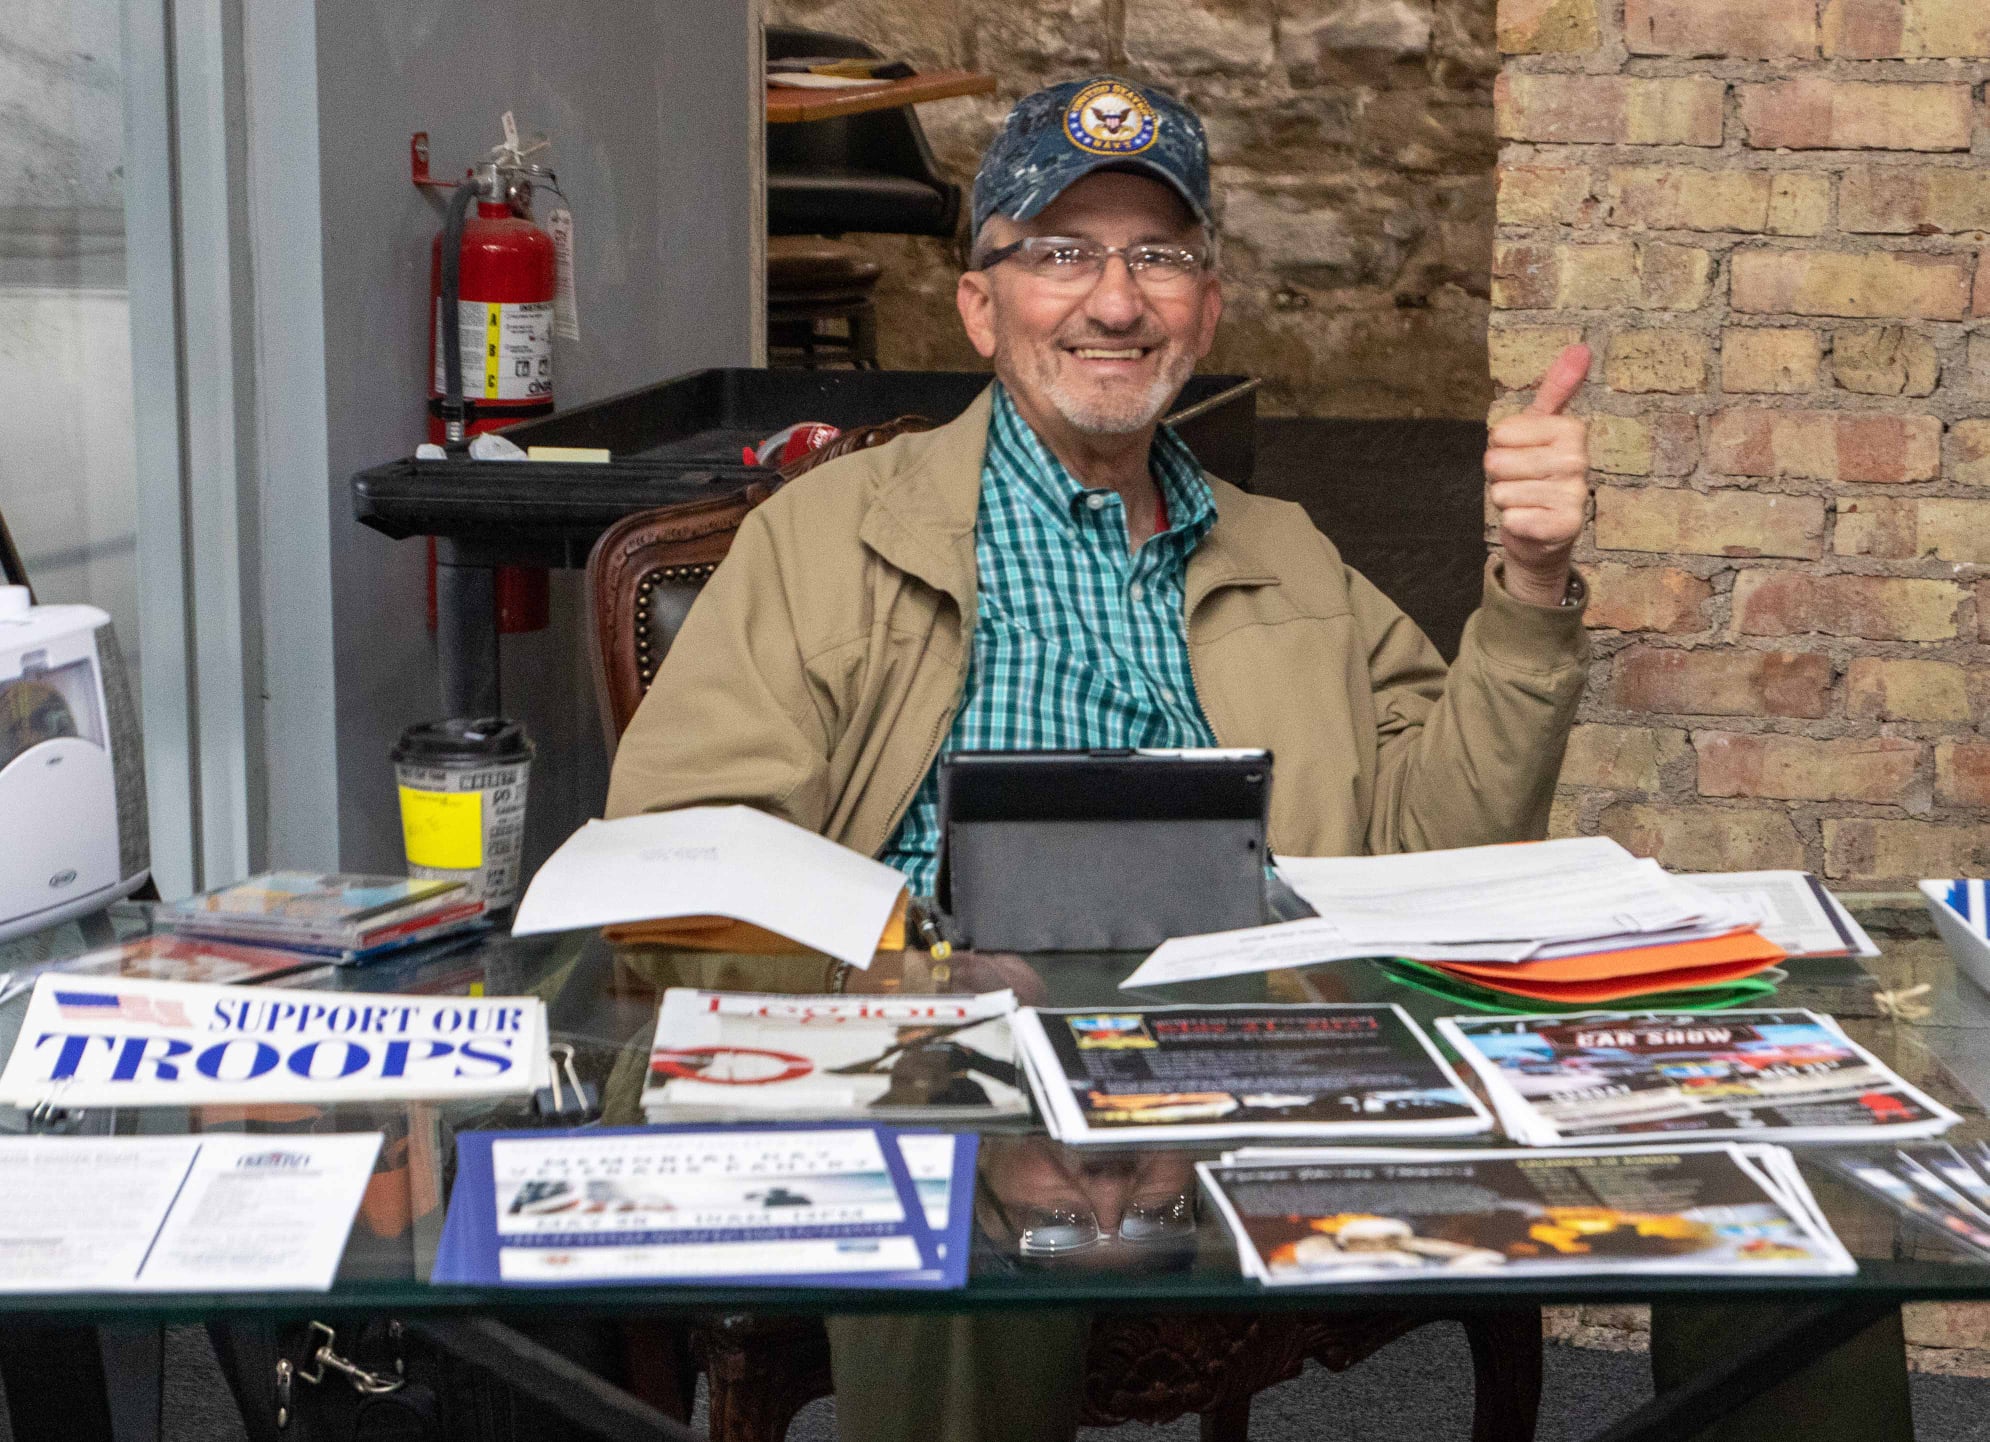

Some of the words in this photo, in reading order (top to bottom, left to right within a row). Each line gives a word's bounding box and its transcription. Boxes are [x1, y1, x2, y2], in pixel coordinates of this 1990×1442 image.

[209, 998, 420, 1032] SUPPORT
[433, 1007, 522, 1032] OUR
[708, 996, 968, 1024] Legion
[1576, 1030, 1636, 1048] CAR
[1647, 1028, 1733, 1046] SHOW
[35, 1032, 514, 1082] TROOPS
